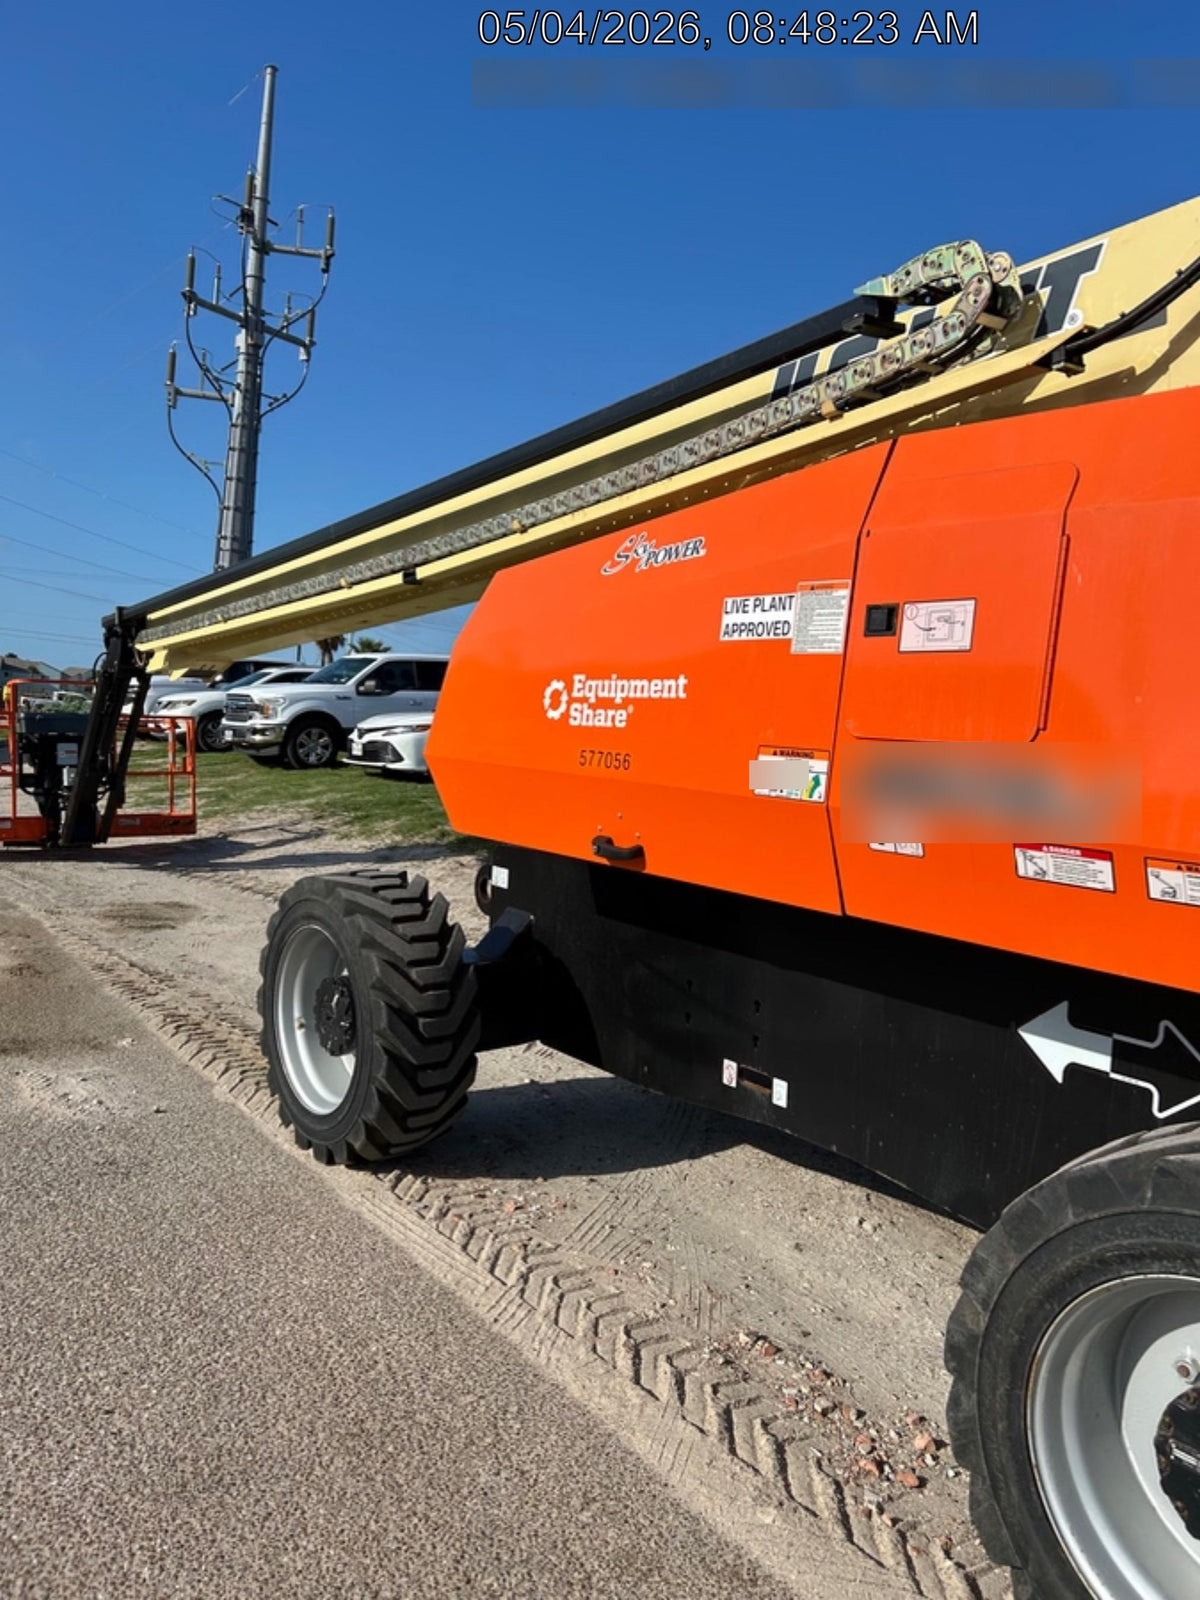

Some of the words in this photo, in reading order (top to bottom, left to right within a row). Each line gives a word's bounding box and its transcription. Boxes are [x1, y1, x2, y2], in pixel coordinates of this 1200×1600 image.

[723, 598, 750, 615] LIVE
[752, 595, 796, 613] PLANT
[722, 620, 792, 638] APPROVED
[571, 673, 688, 704] Equipment
[579, 749, 631, 771] 577056
